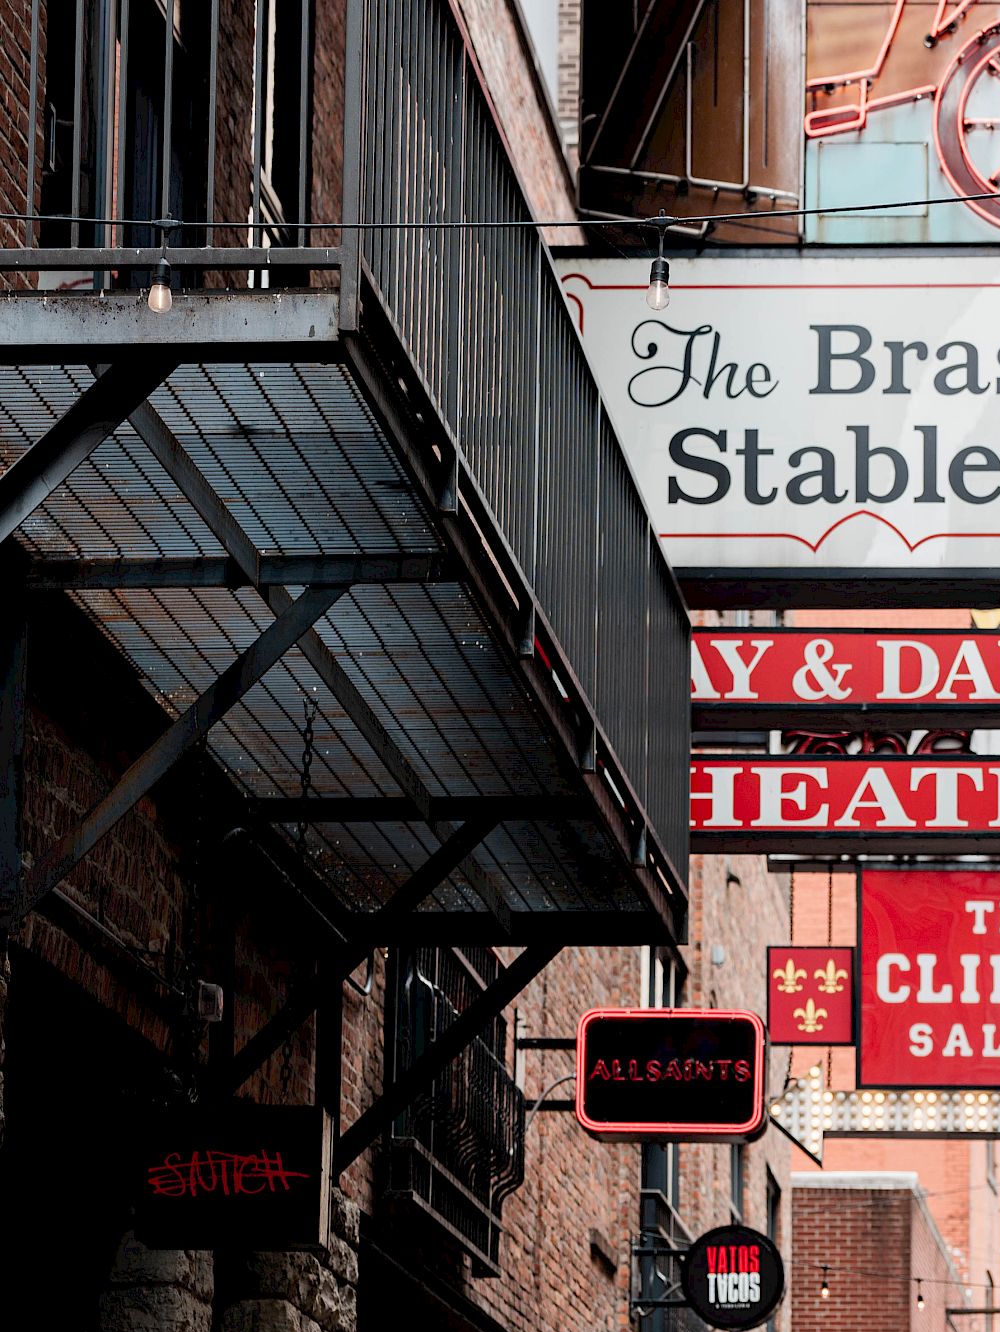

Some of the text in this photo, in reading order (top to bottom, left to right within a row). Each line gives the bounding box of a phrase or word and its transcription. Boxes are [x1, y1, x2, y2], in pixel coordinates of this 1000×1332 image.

[627, 319, 779, 408] The
[793, 638, 853, 700] &
[590, 1058, 751, 1083] ALLSAINTS
[706, 1245, 760, 1273] VATOS
[706, 1272, 760, 1304] TACOS
